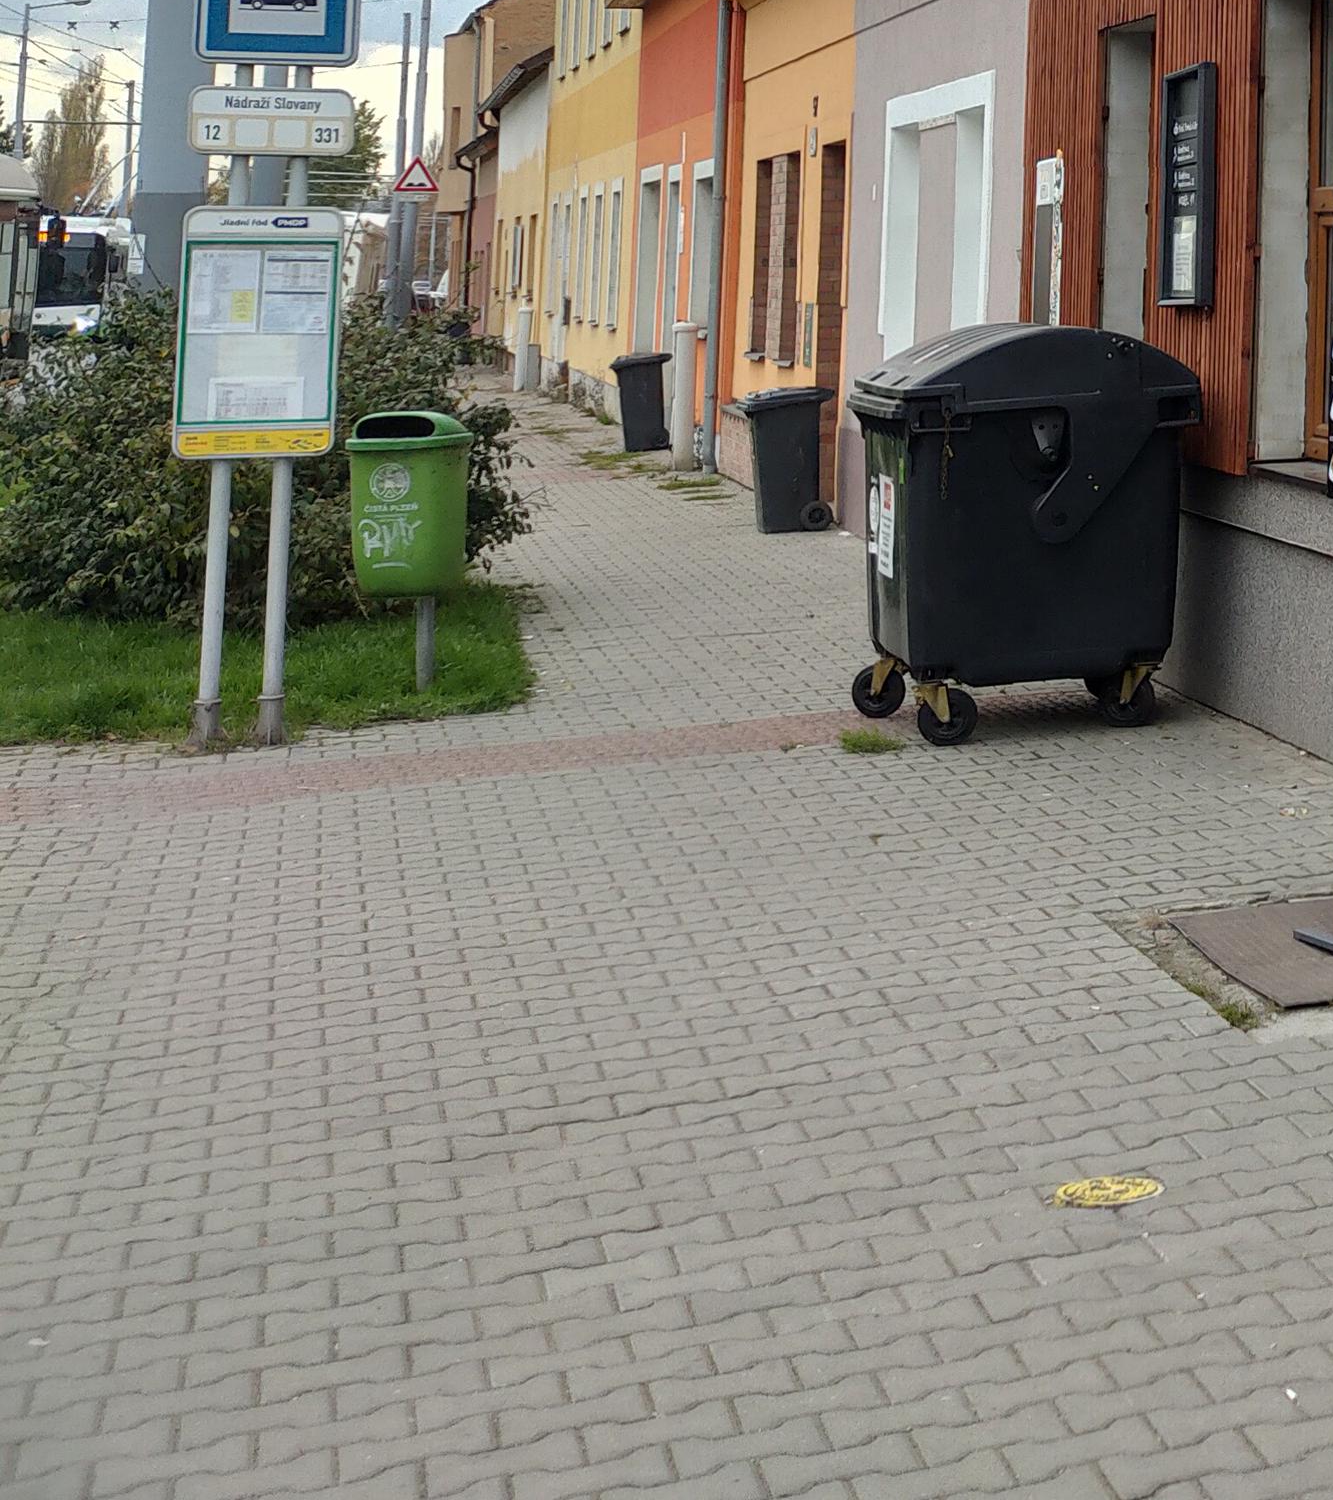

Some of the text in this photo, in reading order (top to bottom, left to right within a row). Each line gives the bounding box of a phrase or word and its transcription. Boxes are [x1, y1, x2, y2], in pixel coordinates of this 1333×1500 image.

[224, 95, 321, 113] Nádraží Slovany
[204, 125, 340, 143] 12 331
